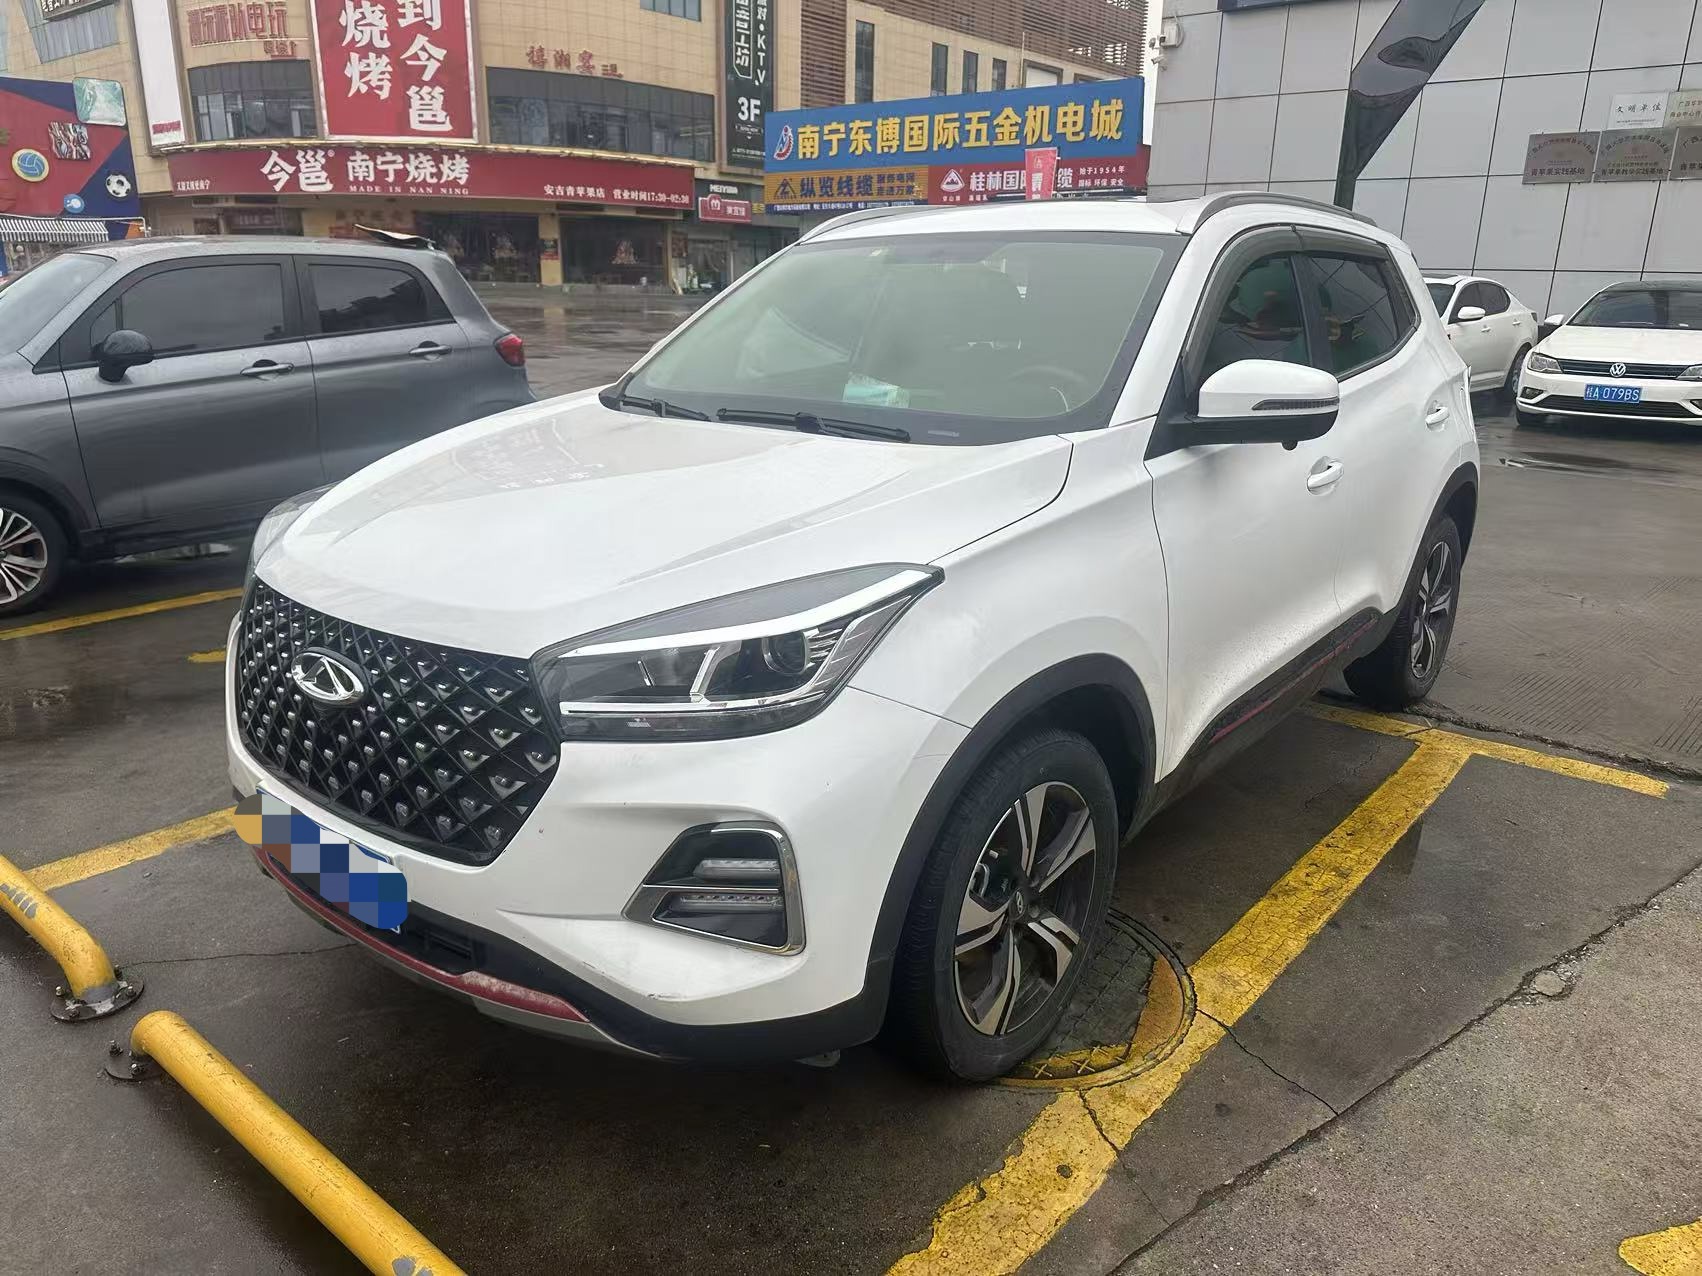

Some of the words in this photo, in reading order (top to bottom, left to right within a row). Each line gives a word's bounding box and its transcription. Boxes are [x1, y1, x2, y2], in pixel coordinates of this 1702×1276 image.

[339, 0, 393, 100] 烧烤
[737, 97, 761, 122] 3F
[797, 98, 1123, 160] 南宁东博国际五金机电城
[260, 149, 333, 192] 今邕
[347, 151, 470, 185] 南宁烧烤
[349, 185, 381, 193] MADE
[409, 186, 433, 194] NAN
[440, 187, 469, 195] NING
[543, 184, 606, 199] 安吉青苹果店
